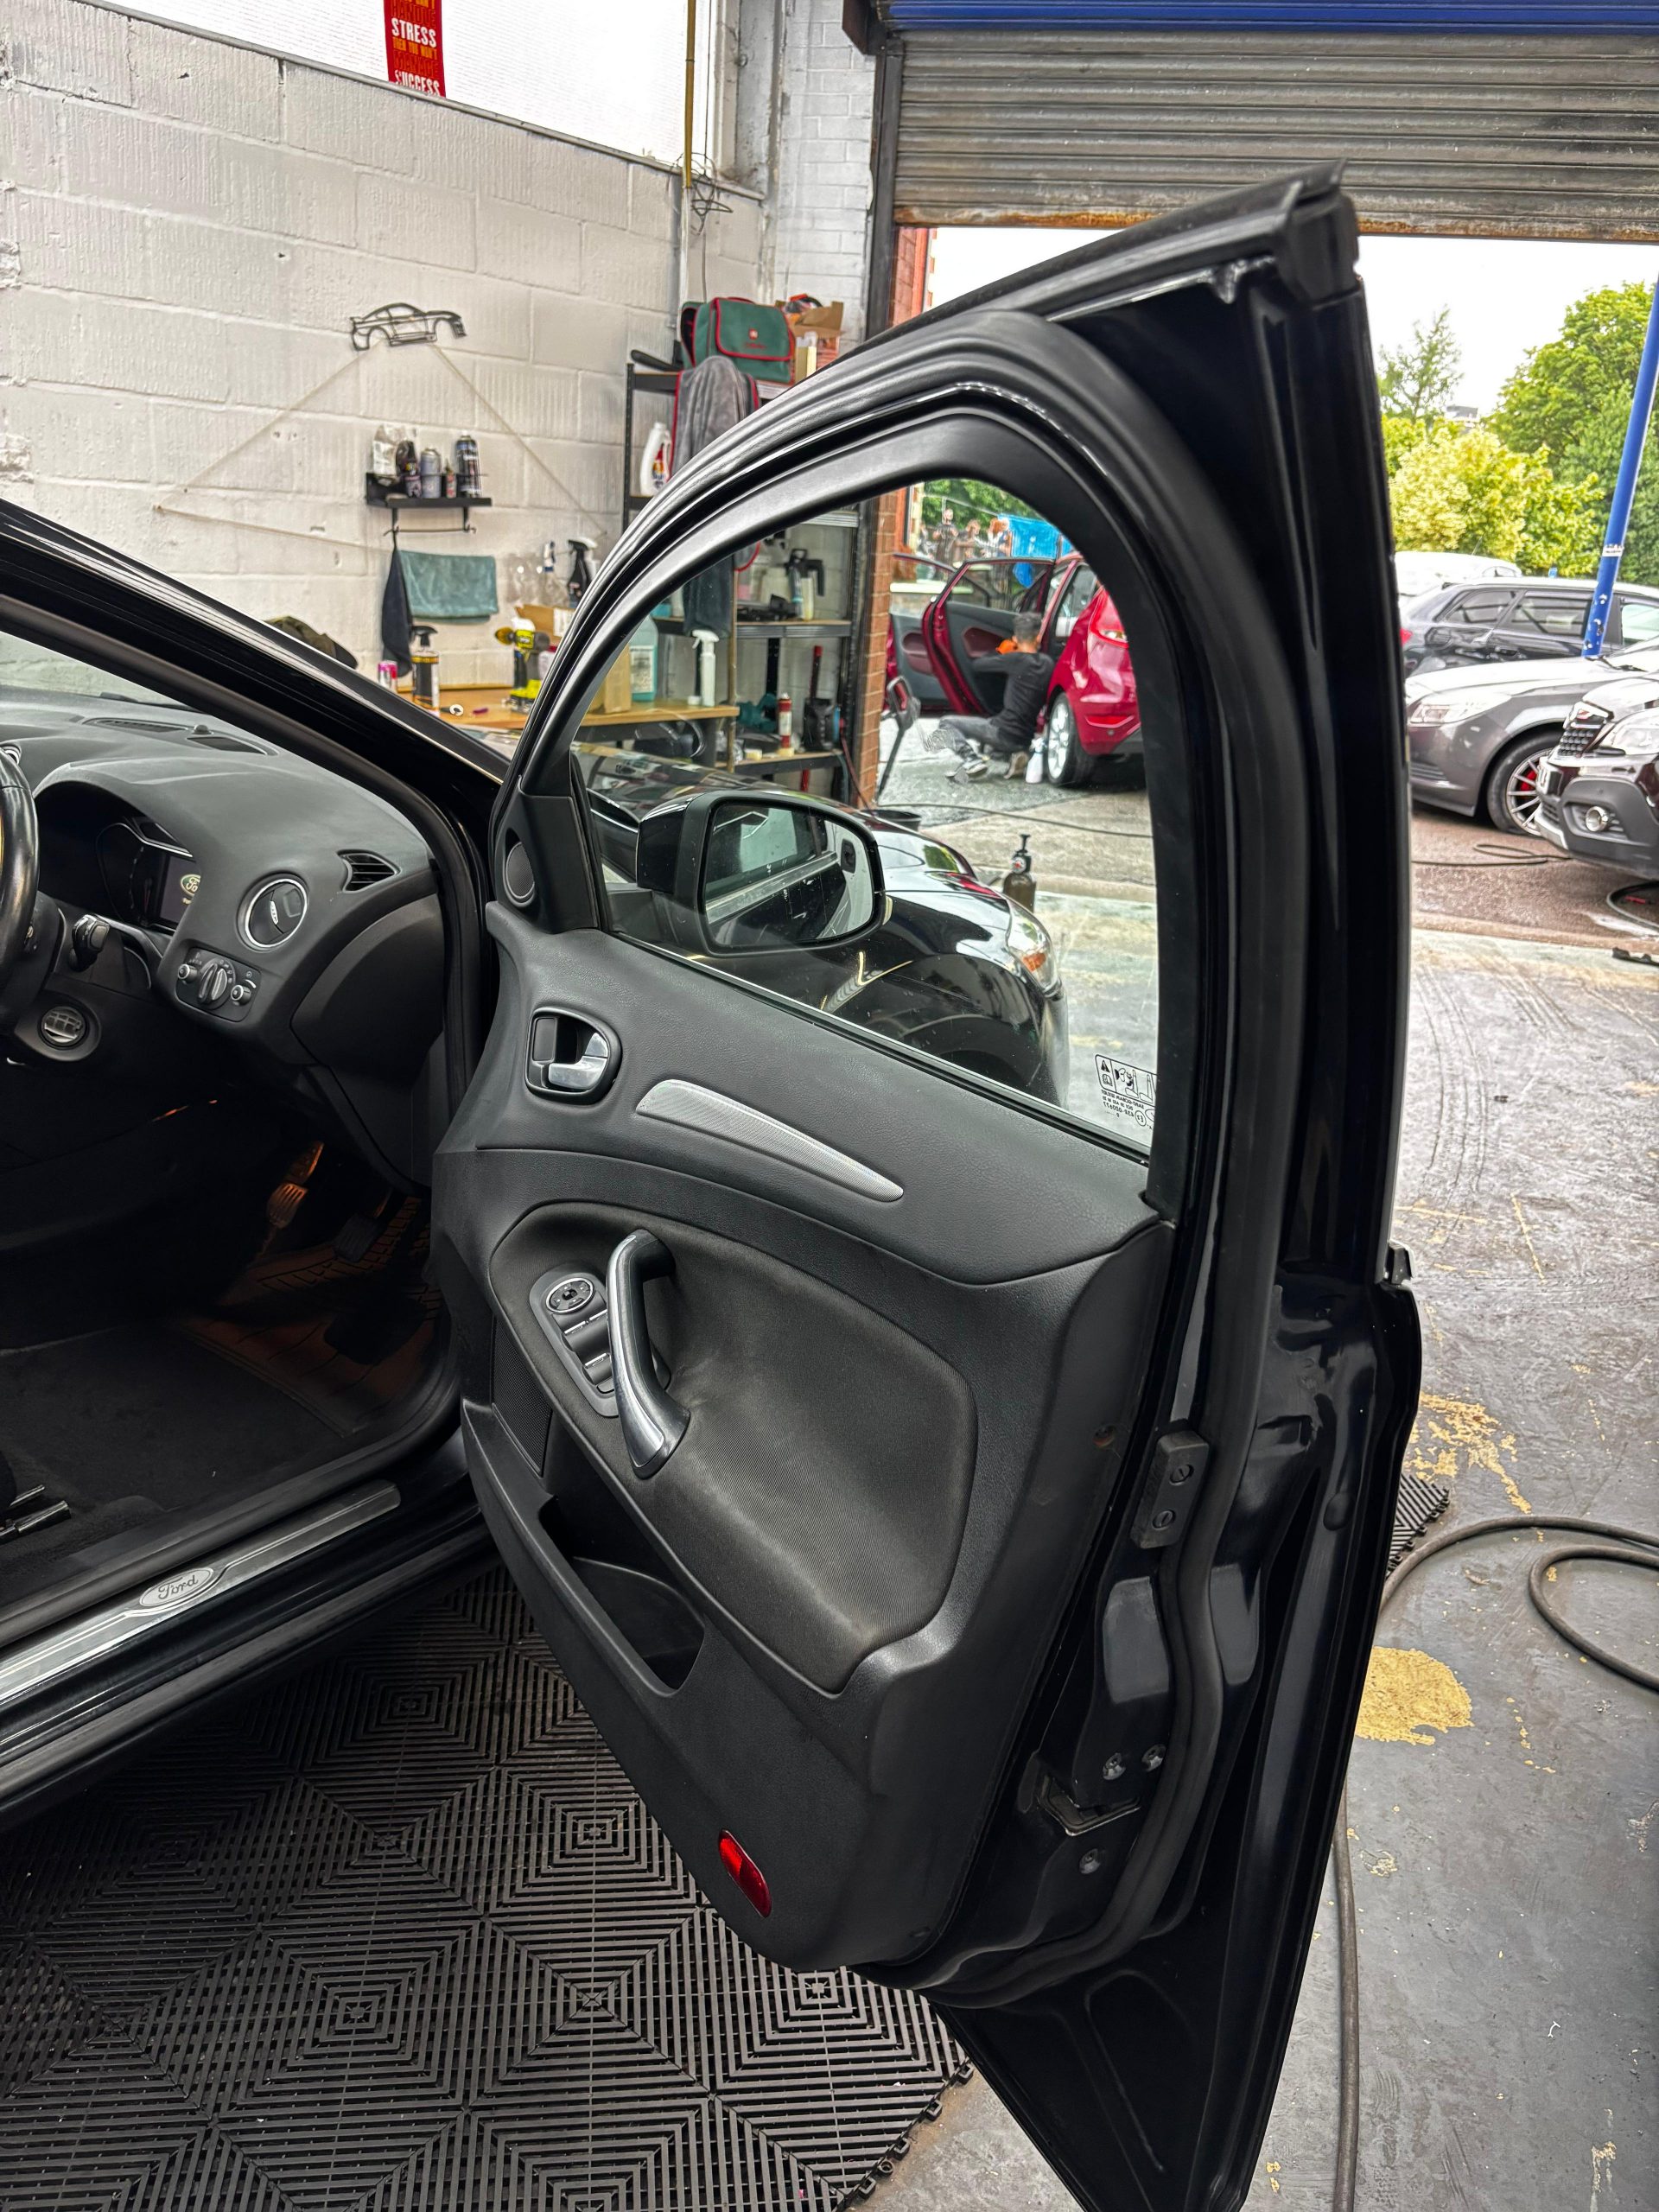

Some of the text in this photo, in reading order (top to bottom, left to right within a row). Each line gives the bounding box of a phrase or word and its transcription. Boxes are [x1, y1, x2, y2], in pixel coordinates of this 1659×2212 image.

[391, 17, 437, 48] STRESS
[394, 69, 441, 97] SUCCESS
[186, 877, 200, 893] Fo
[157, 1574, 199, 1599] Ford
